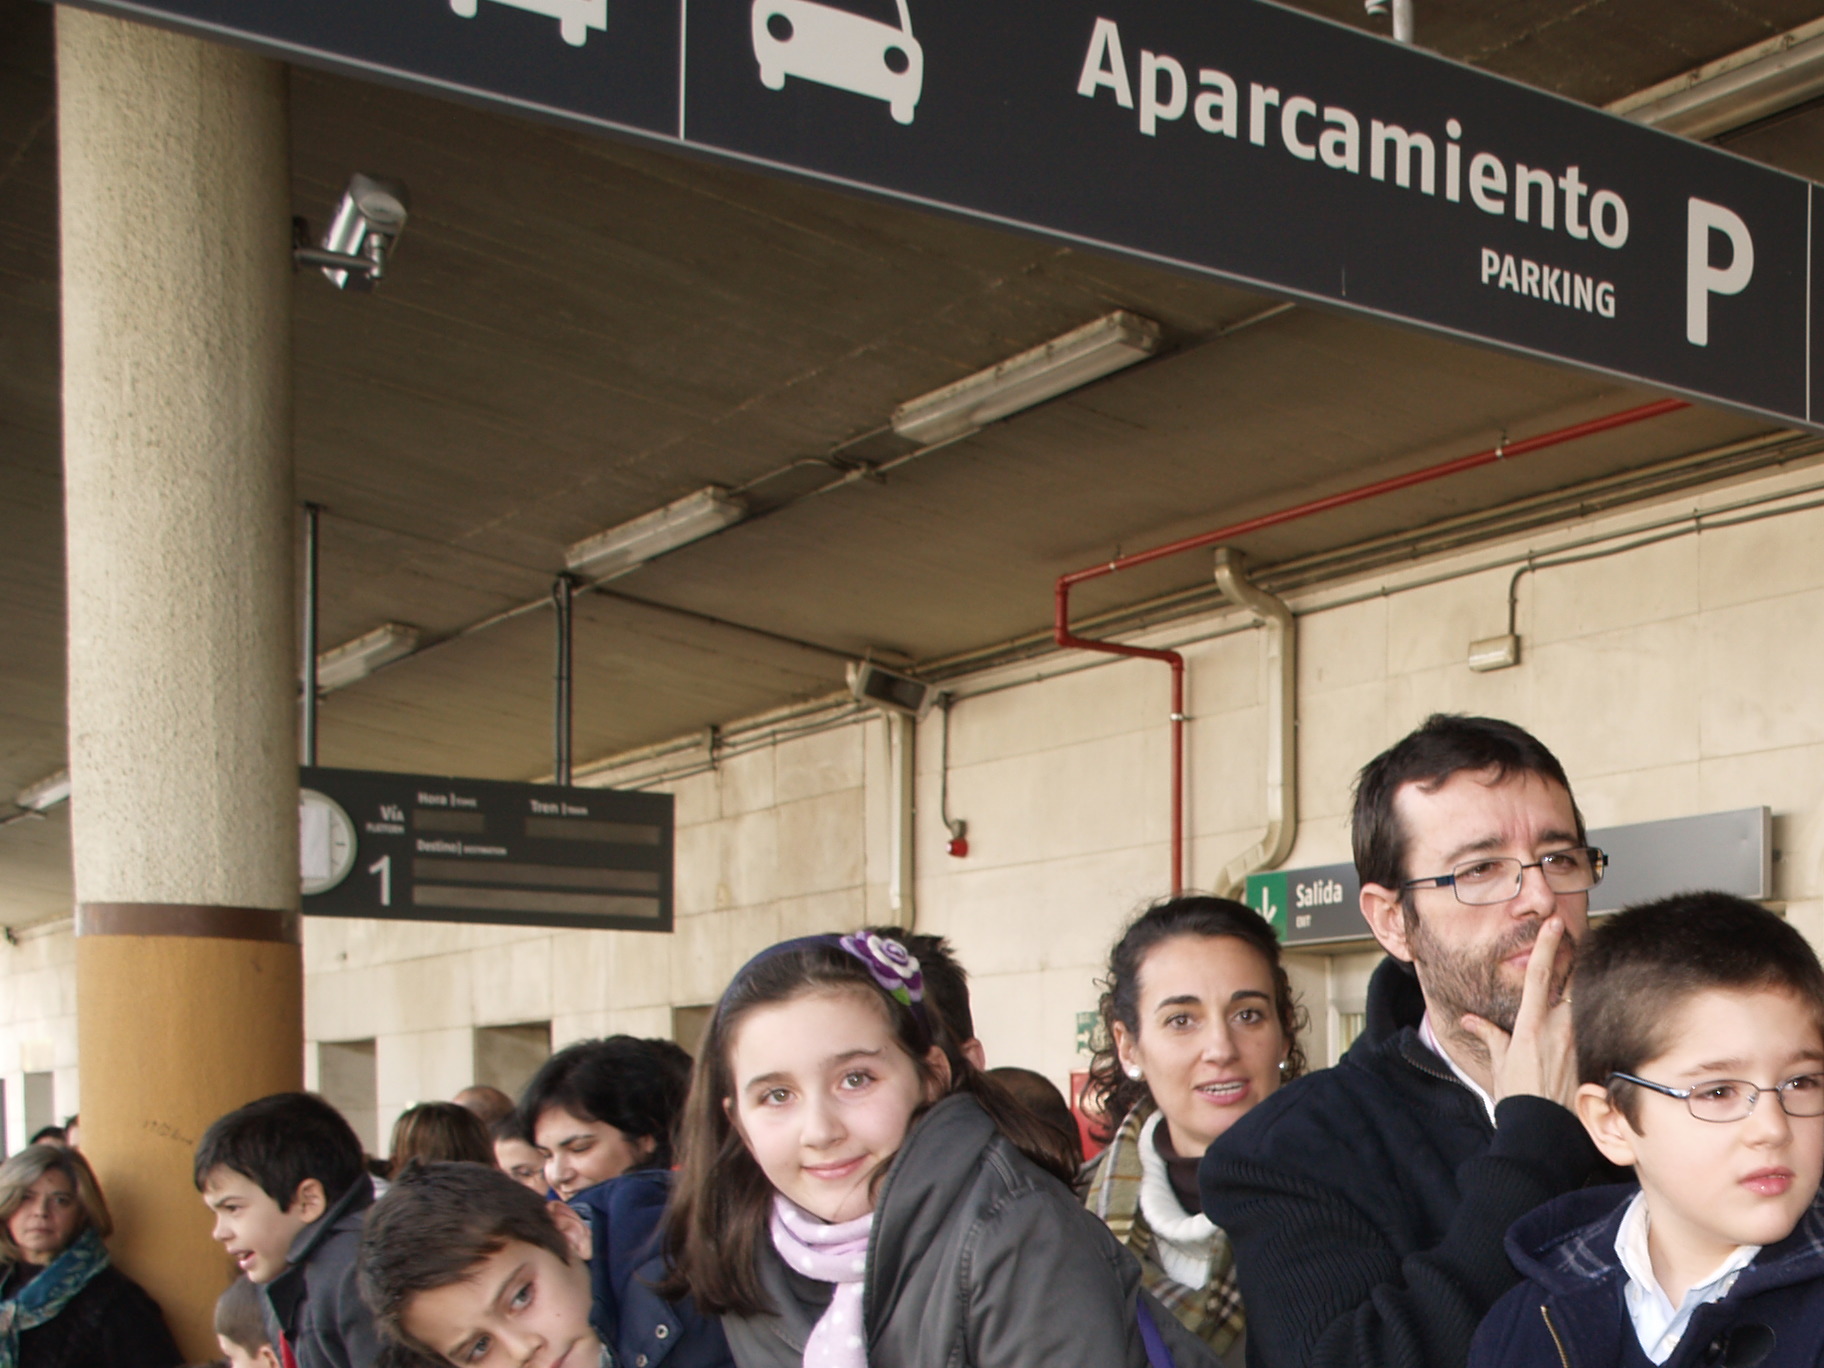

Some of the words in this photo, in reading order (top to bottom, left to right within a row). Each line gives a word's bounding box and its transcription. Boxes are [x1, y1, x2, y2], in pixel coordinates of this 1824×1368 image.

[1077, 17, 1629, 250] Aparcamiento
[1481, 247, 1616, 318] PARKING
[1686, 196, 1754, 347] P
[530, 799, 559, 815] Tren
[368, 854, 391, 907] 1
[1295, 878, 1344, 909] Salida
